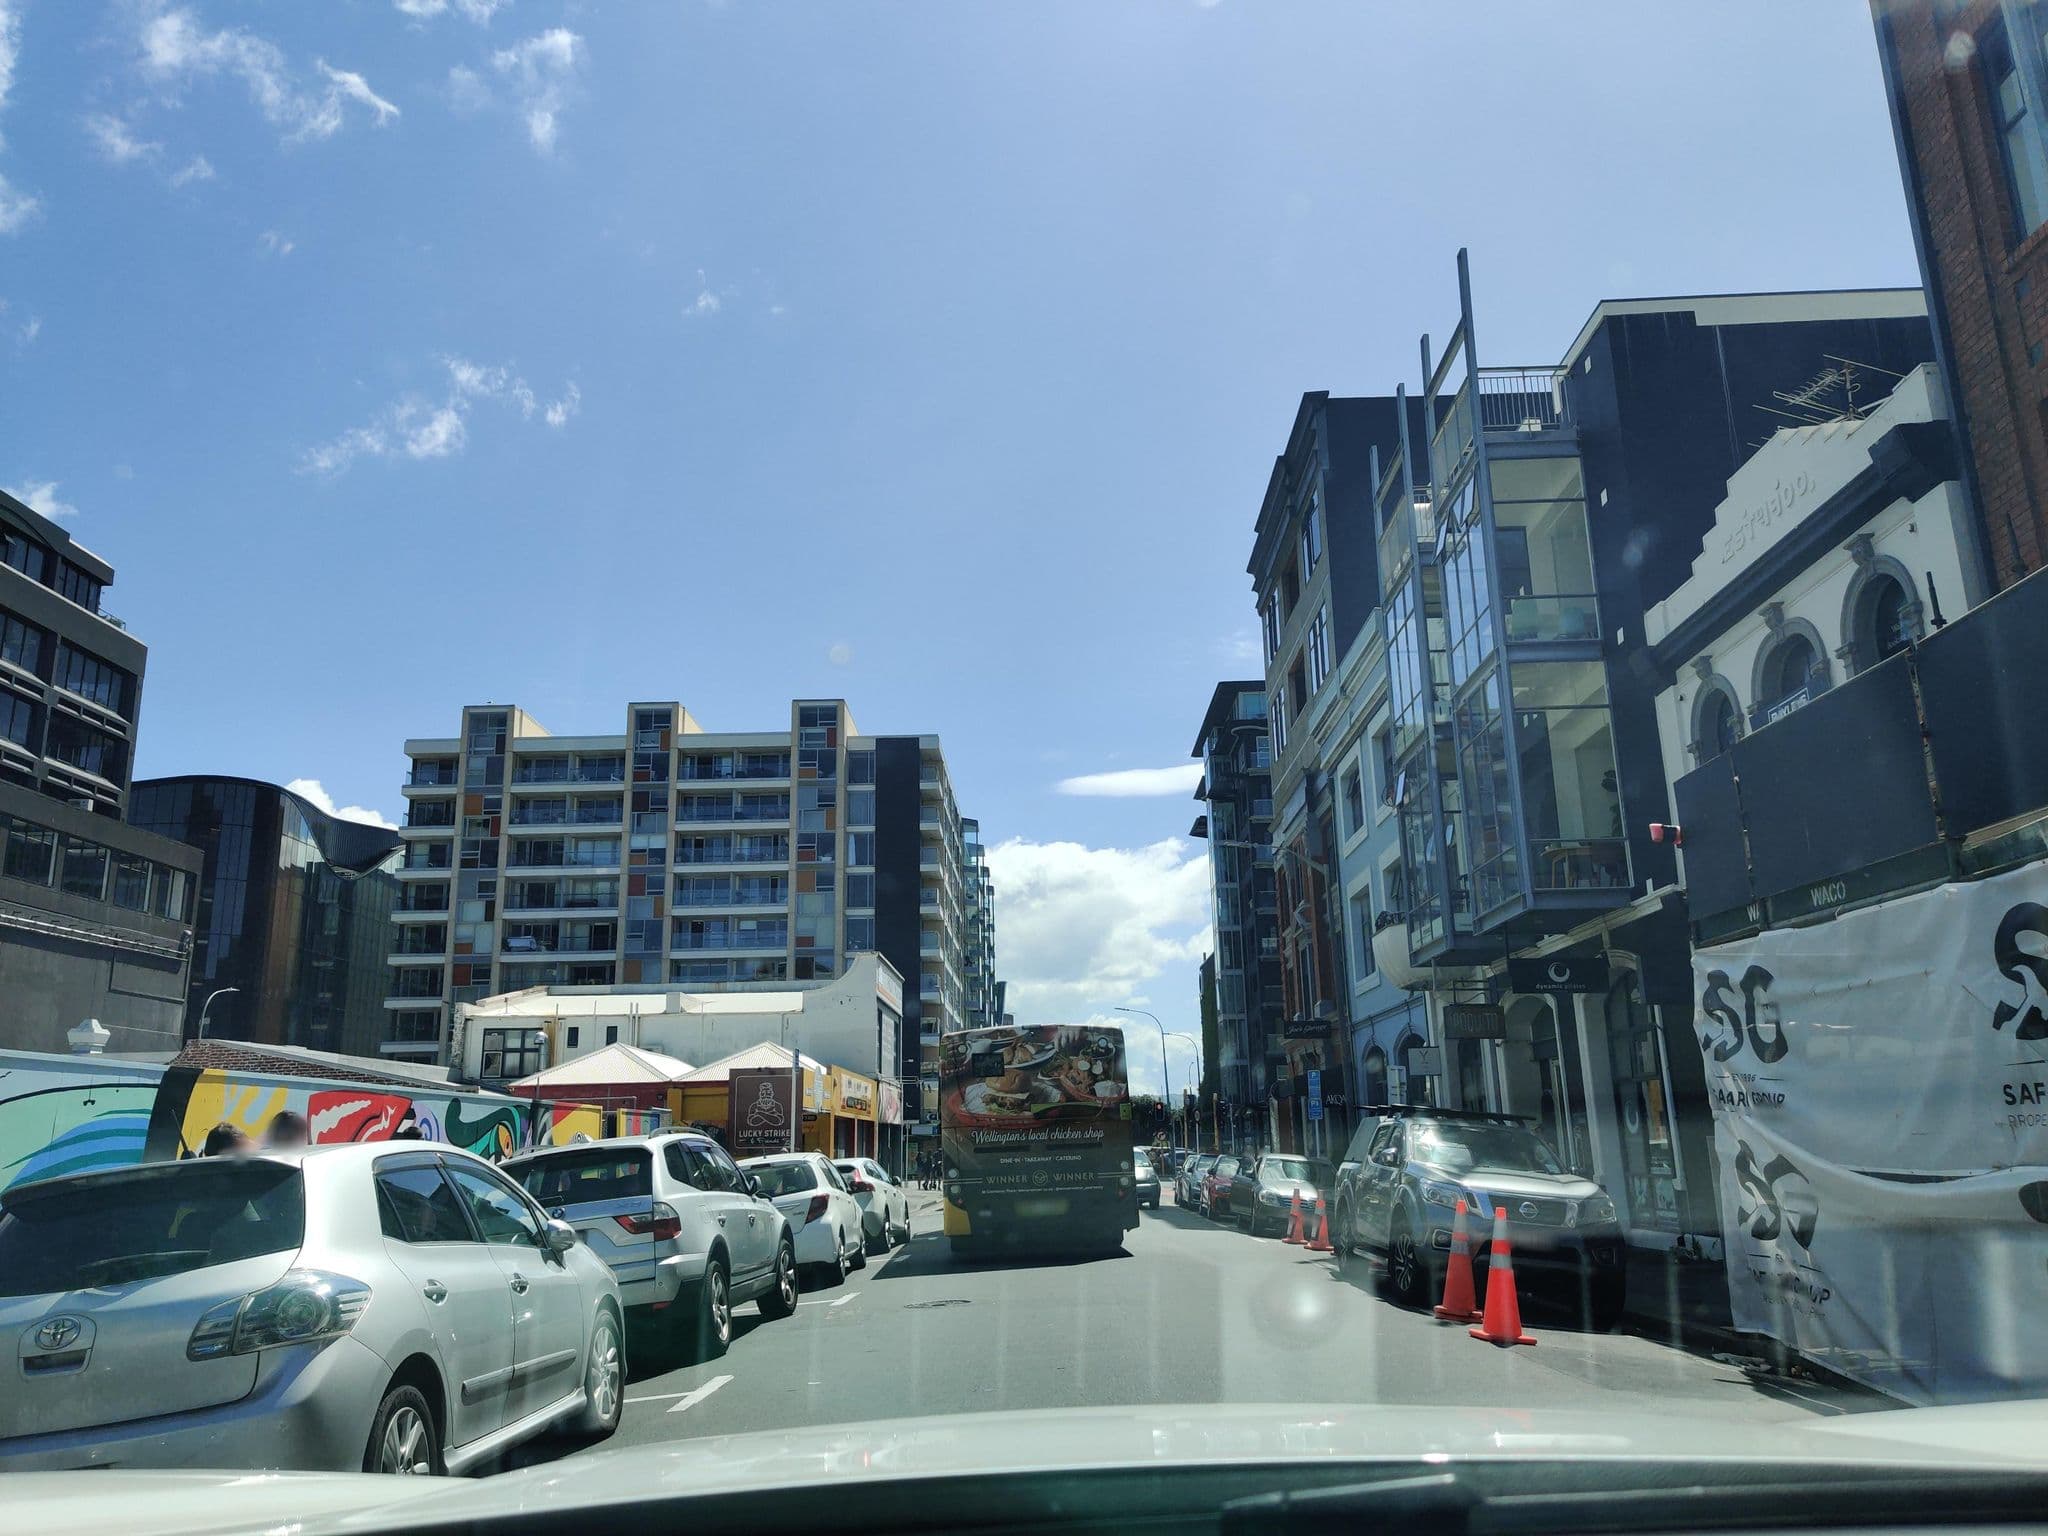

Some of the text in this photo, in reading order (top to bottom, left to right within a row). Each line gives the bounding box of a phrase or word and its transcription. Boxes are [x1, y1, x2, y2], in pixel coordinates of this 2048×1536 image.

[1810, 880, 1846, 907] WACO
[738, 1128, 791, 1138] LUCKY STRIKE
[971, 1125, 1104, 1144] Wellington's local chicken shop
[985, 1171, 1095, 1185] WINNER WINNER
